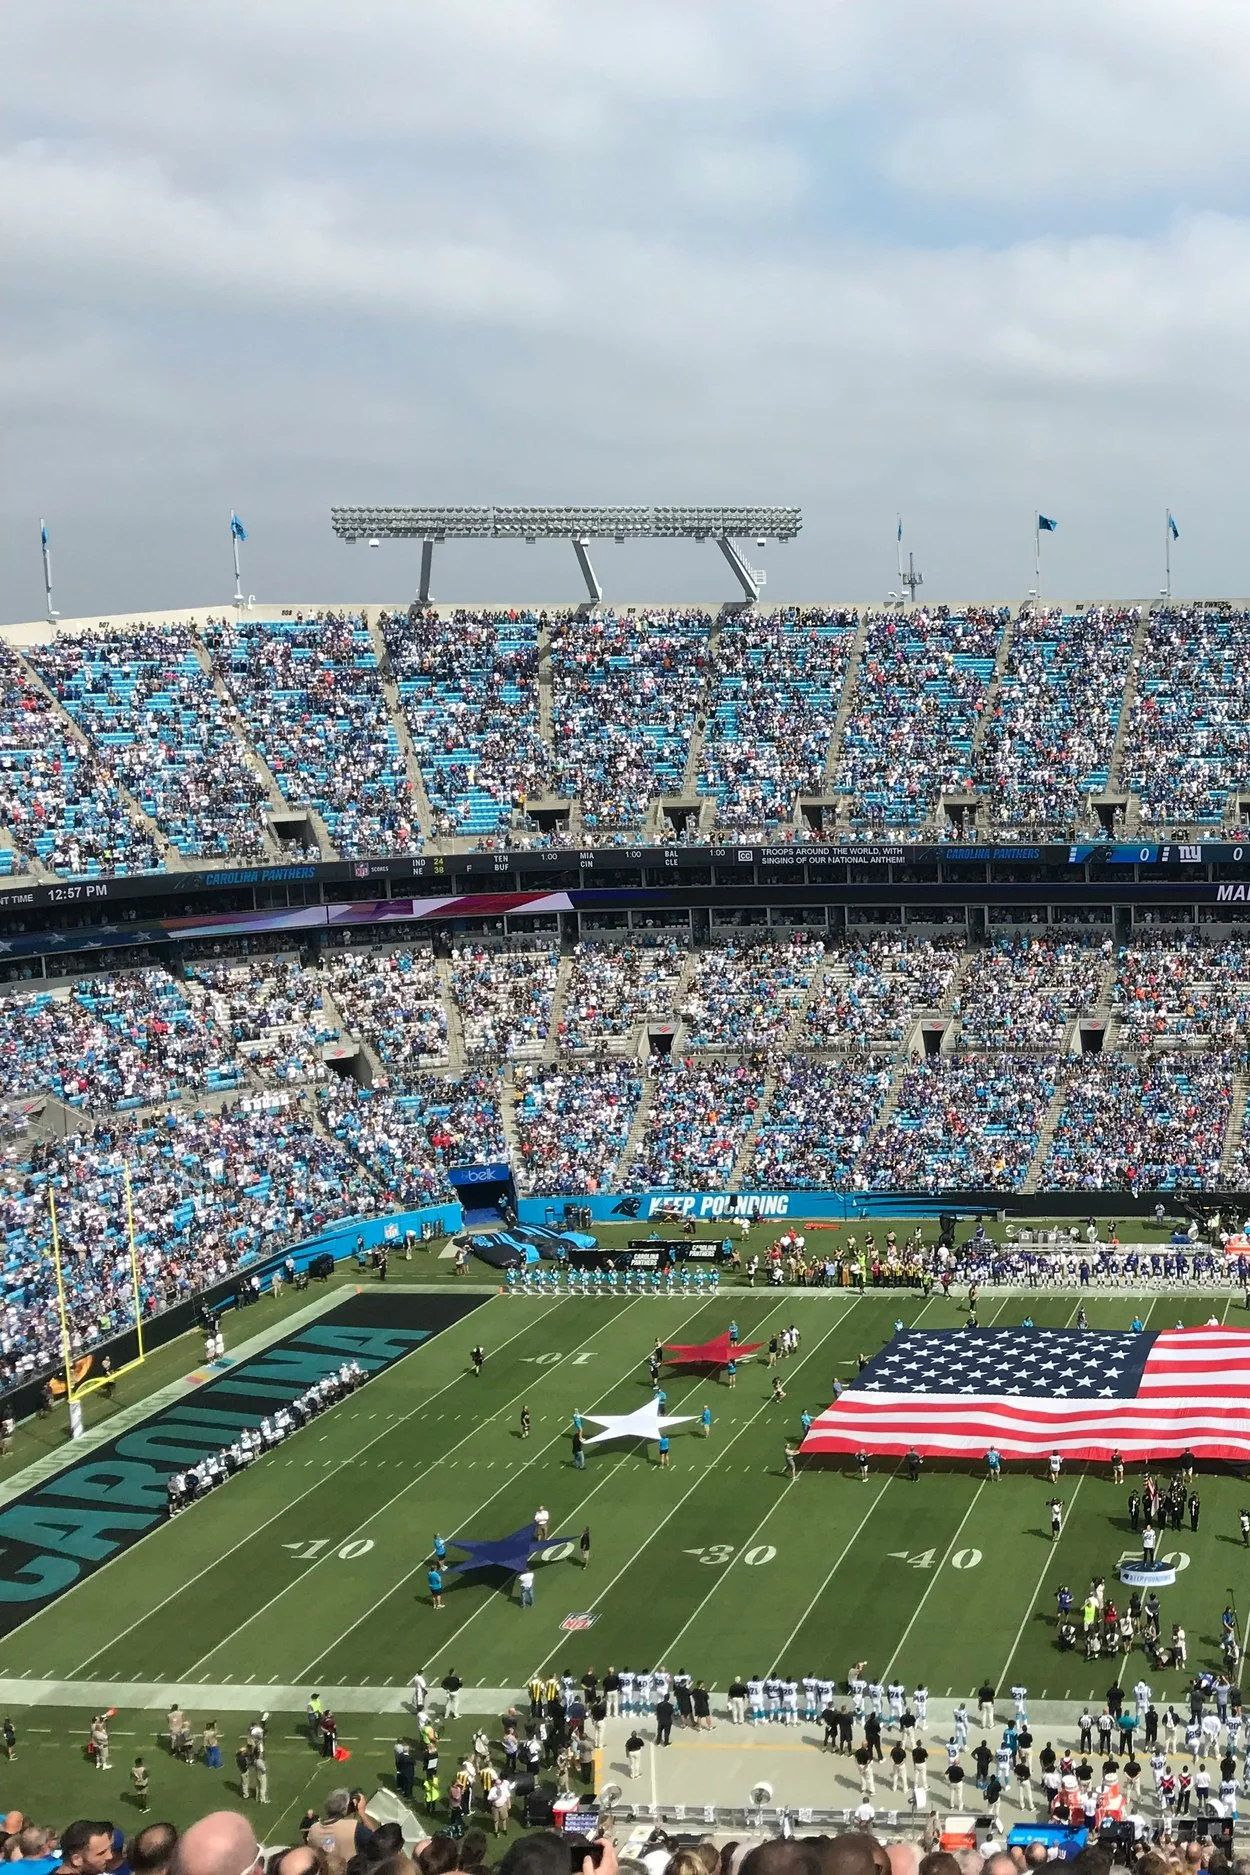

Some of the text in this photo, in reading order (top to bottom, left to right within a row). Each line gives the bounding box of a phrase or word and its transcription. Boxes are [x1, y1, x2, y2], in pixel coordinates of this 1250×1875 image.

[579, 852, 595, 860] MIA
[664, 850, 679, 858] BAL
[709, 849, 726, 858] 1:00
[761, 848, 795, 856] TROOPS
[795, 848, 830, 856] AROUND
[850, 848, 882, 857] WORLD,
[882, 847, 904, 855] WITH
[946, 847, 1041, 860] CAROLINA PANTHERS
[1139, 847, 1151, 862] 0
[1232, 847, 1244, 862] 0
[412, 859, 427, 868] IND
[433, 857, 445, 866] 24
[493, 855, 509, 863] TEN
[664, 859, 679, 867] CLE
[761, 857, 794, 865] SINGING
[795, 857, 808, 865] OF
[808, 857, 827, 865] OUR
[869, 856, 907, 864] ANTHEM!
[466, 865, 473, 873] F
[493, 863, 510, 872] BUF
[580, 860, 594, 869] CIN
[371, 865, 390, 874] SCORES
[413, 867, 424, 876] NE
[433, 866, 445, 875] 38
[206, 866, 317, 887] CAROLINA PANTHERS
[48, 884, 108, 902] 12:57 PM
[11, 894, 34, 905] TIME
[468, 1168, 496, 1182] belk
[689, 1251, 716, 1259] PANTHERS
[630, 1259, 660, 1267] PANTHERS
[291, 1538, 376, 1560] 10
[697, 1544, 778, 1567] 30
[905, 1547, 984, 1570] 40
[997, 1754, 1009, 1763] 20
